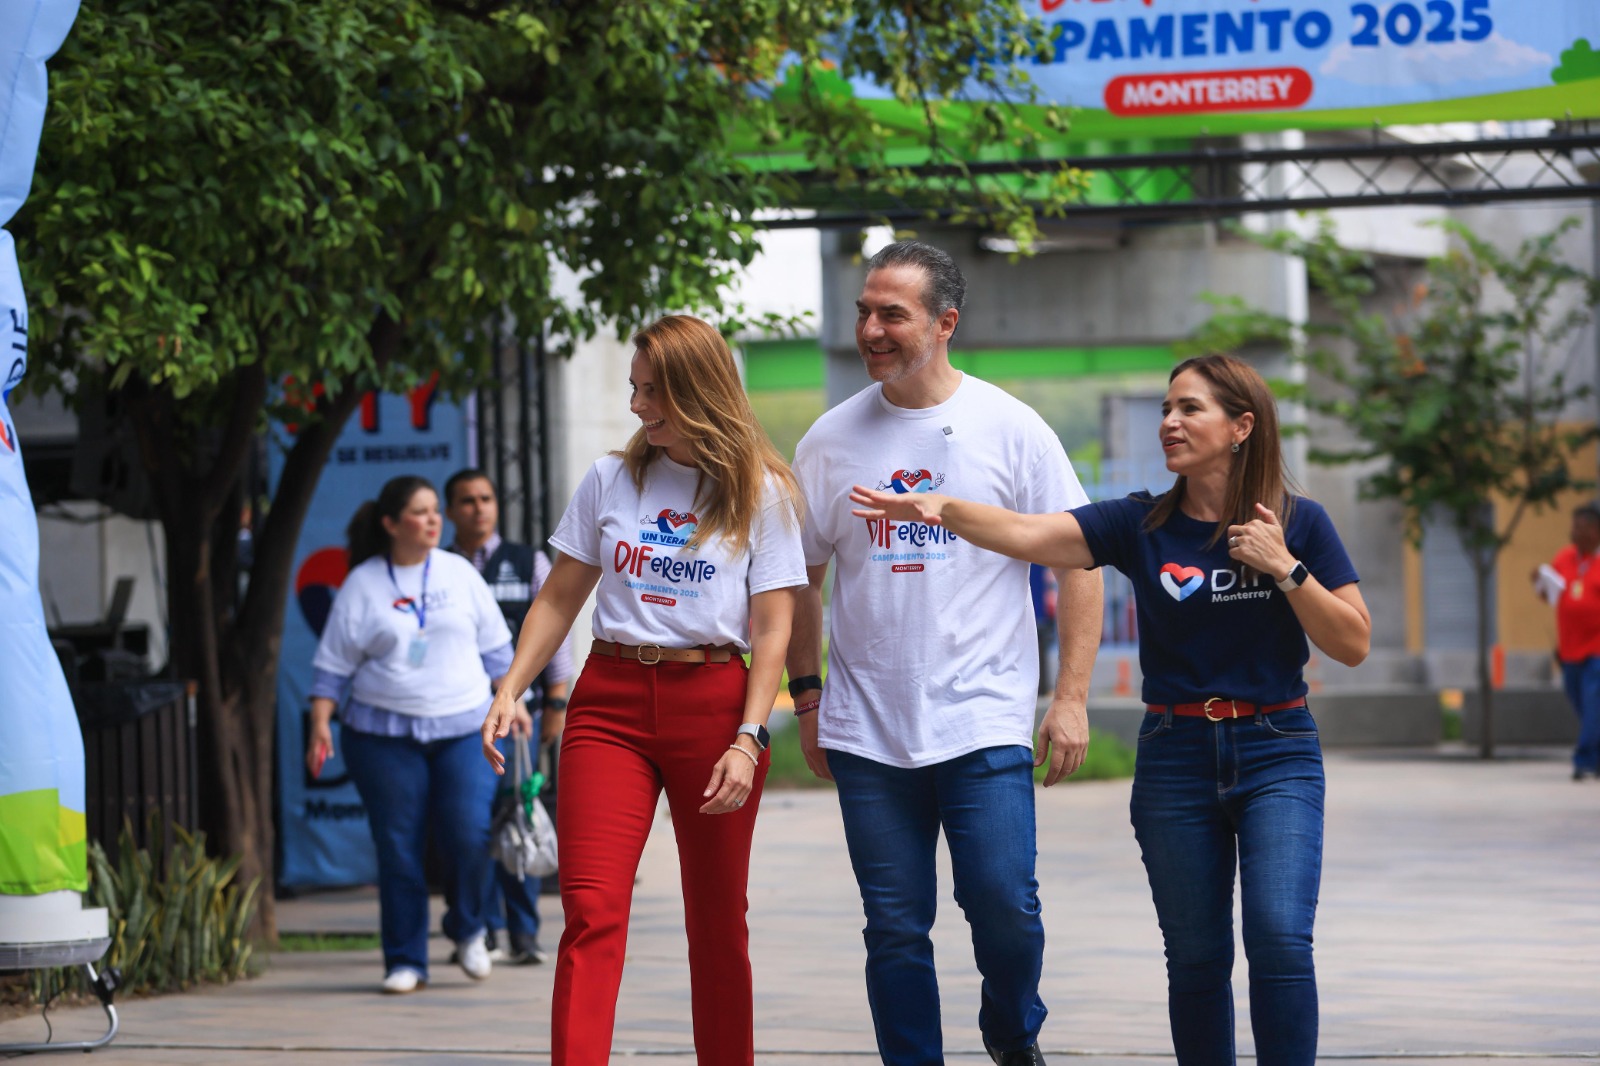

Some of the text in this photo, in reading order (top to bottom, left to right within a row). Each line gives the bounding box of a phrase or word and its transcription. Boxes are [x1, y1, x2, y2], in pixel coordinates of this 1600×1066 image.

[1349, 0, 1493, 47] 2025
[1122, 74, 1294, 107] MONTERREY
[641, 532, 658, 541] UN
[872, 552, 946, 562] CAMPAMENTO 2025
[624, 580, 699, 598] CAMPAMENTO 2025
[1211, 589, 1272, 603] Monterrey
